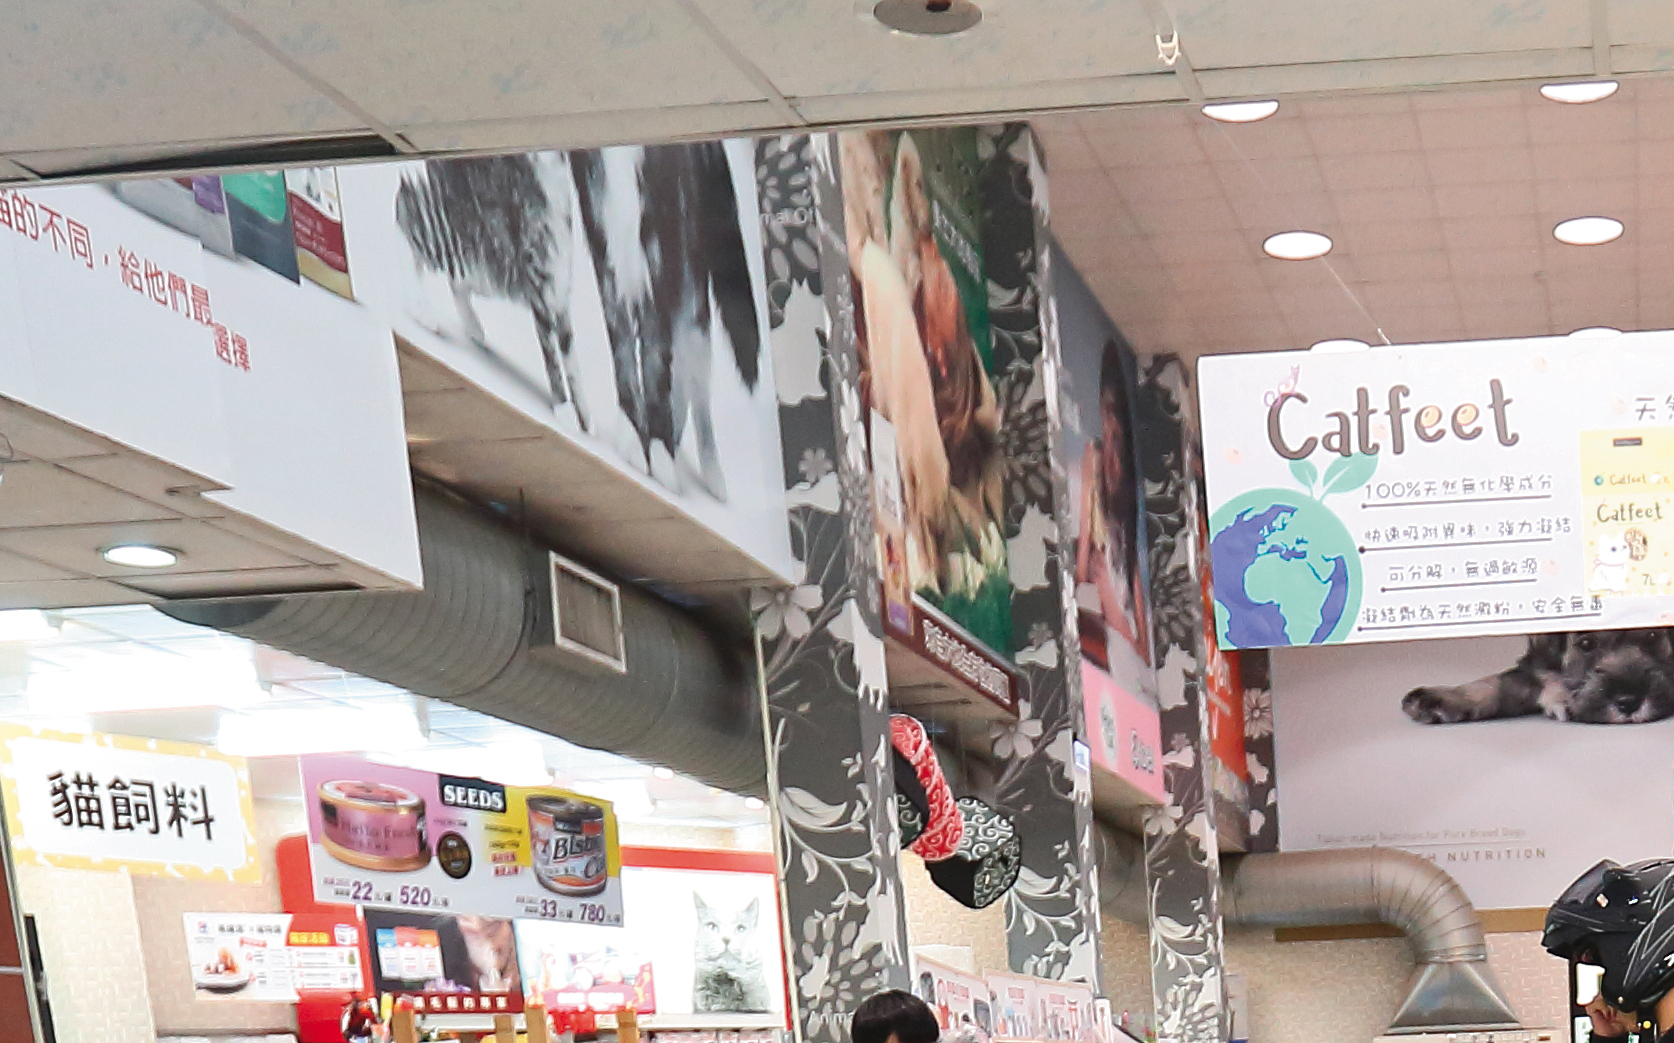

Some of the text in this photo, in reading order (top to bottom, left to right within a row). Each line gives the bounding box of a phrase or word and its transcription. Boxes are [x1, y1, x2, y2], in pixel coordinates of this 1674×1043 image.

[1266, 379, 1520, 461] Catfeet
[1597, 502, 1664, 523] Catfeet
[50, 771, 215, 840] 貓飼料
[443, 784, 504, 810] SEEDS
[1447, 849, 1546, 862] NUTRITION
[352, 881, 373, 902] 22
[400, 886, 431, 907] 520
[540, 899, 557, 918] 33
[580, 903, 604, 922] 780
